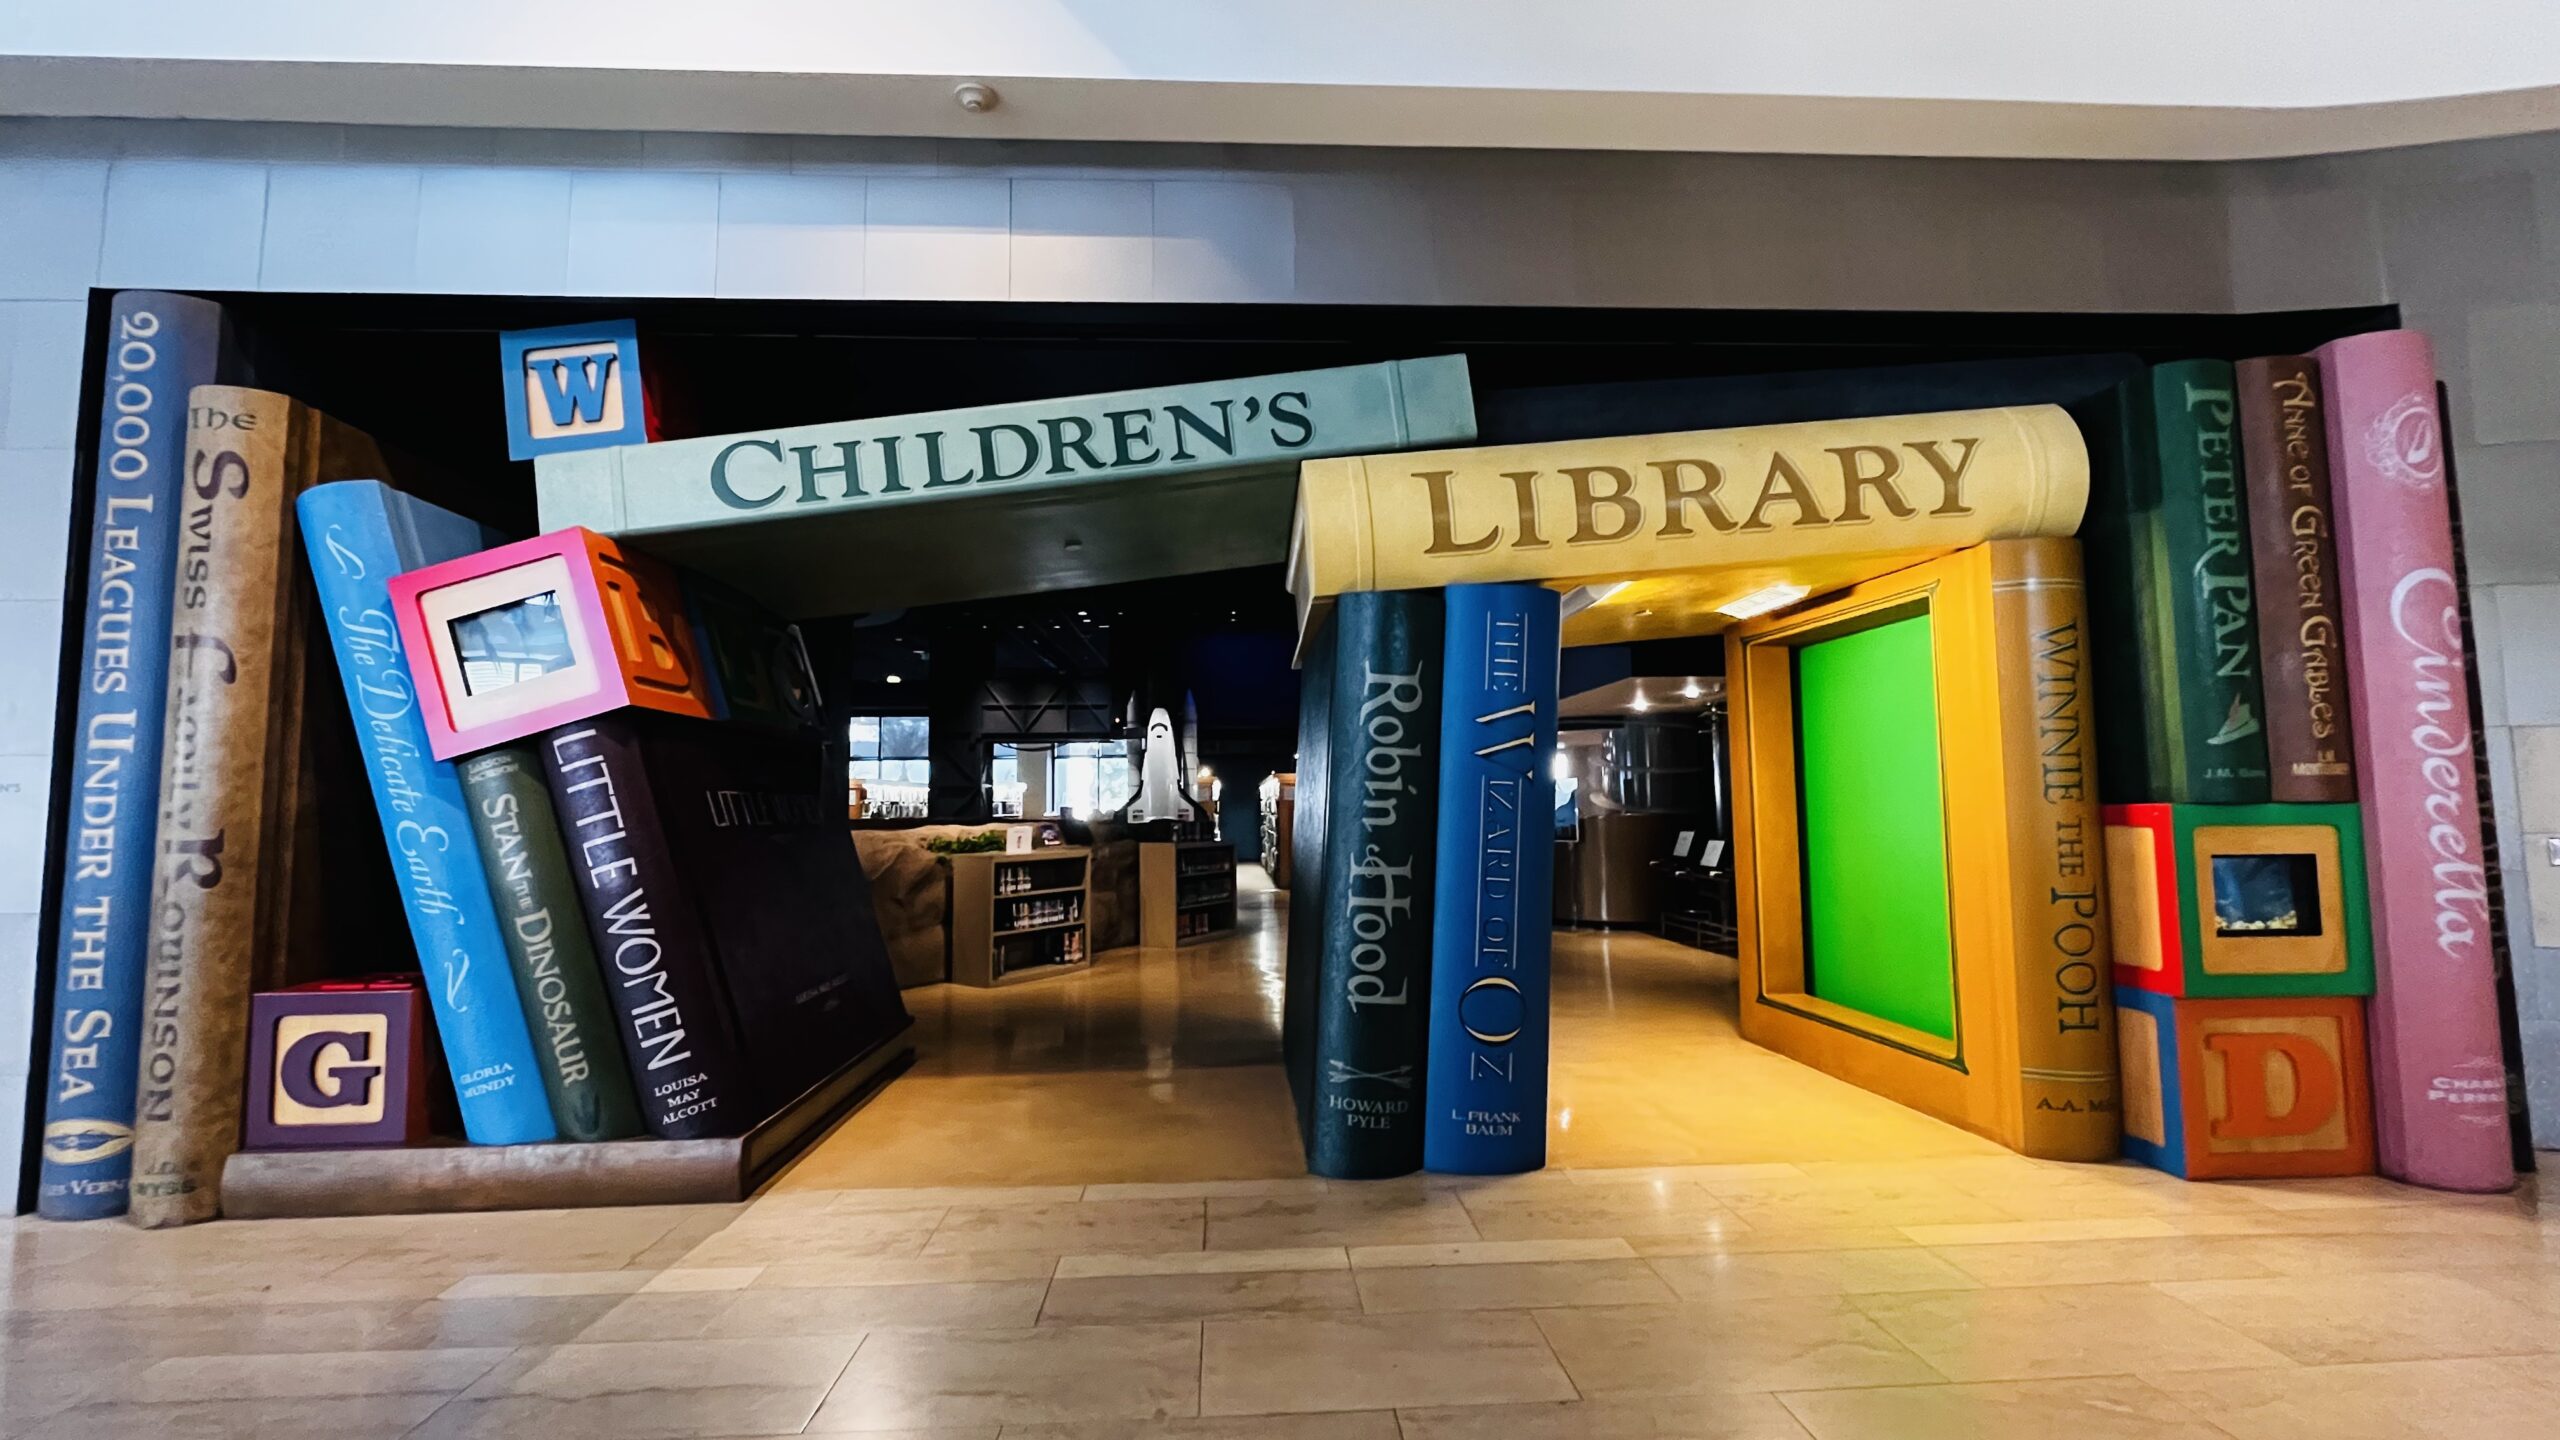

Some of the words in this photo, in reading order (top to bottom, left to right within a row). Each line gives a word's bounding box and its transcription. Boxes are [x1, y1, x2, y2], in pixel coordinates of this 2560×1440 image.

[109, 311, 159, 481] 20,000
[527, 353, 617, 426] W
[711, 391, 1316, 510] CHILDREN'S
[1411, 438, 1981, 556] LIBRARY
[2185, 382, 2240, 577] PETER
[93, 494, 153, 695] LEAGUES
[339, 606, 401, 667] The
[2201, 568, 2251, 677] PAN
[1493, 612, 1521, 691] THE
[356, 670, 422, 813] Delicate
[1359, 659, 1423, 833] Robin
[2032, 620, 2085, 807] WINNIE
[2390, 568, 2488, 959] Cinderella
[75, 708, 138, 882] UNDER
[2056, 816, 2085, 879] THE
[396, 819, 464, 925] Earth
[553, 729, 638, 889] LITTLE
[603, 887, 692, 1070] WOMEN
[68, 896, 110, 992] THE
[482, 793, 533, 883] STAN
[515, 907, 589, 1088] DINOSAUR
[1347, 845, 1413, 1014] Hood
[2050, 884, 2100, 1035] POOH
[59, 1008, 112, 1103] SEA
[281, 1031, 380, 1108] G
[654, 1072, 708, 1097] LOUISA
[667, 1088, 701, 1108] MAY
[1329, 1095, 1408, 1114] HOWARD
[2204, 1032, 2339, 1140] D
[662, 1097, 719, 1126] ALCOTT
[1347, 1114, 1391, 1129] PYLE
[1466, 1123, 1512, 1136] BAUM
